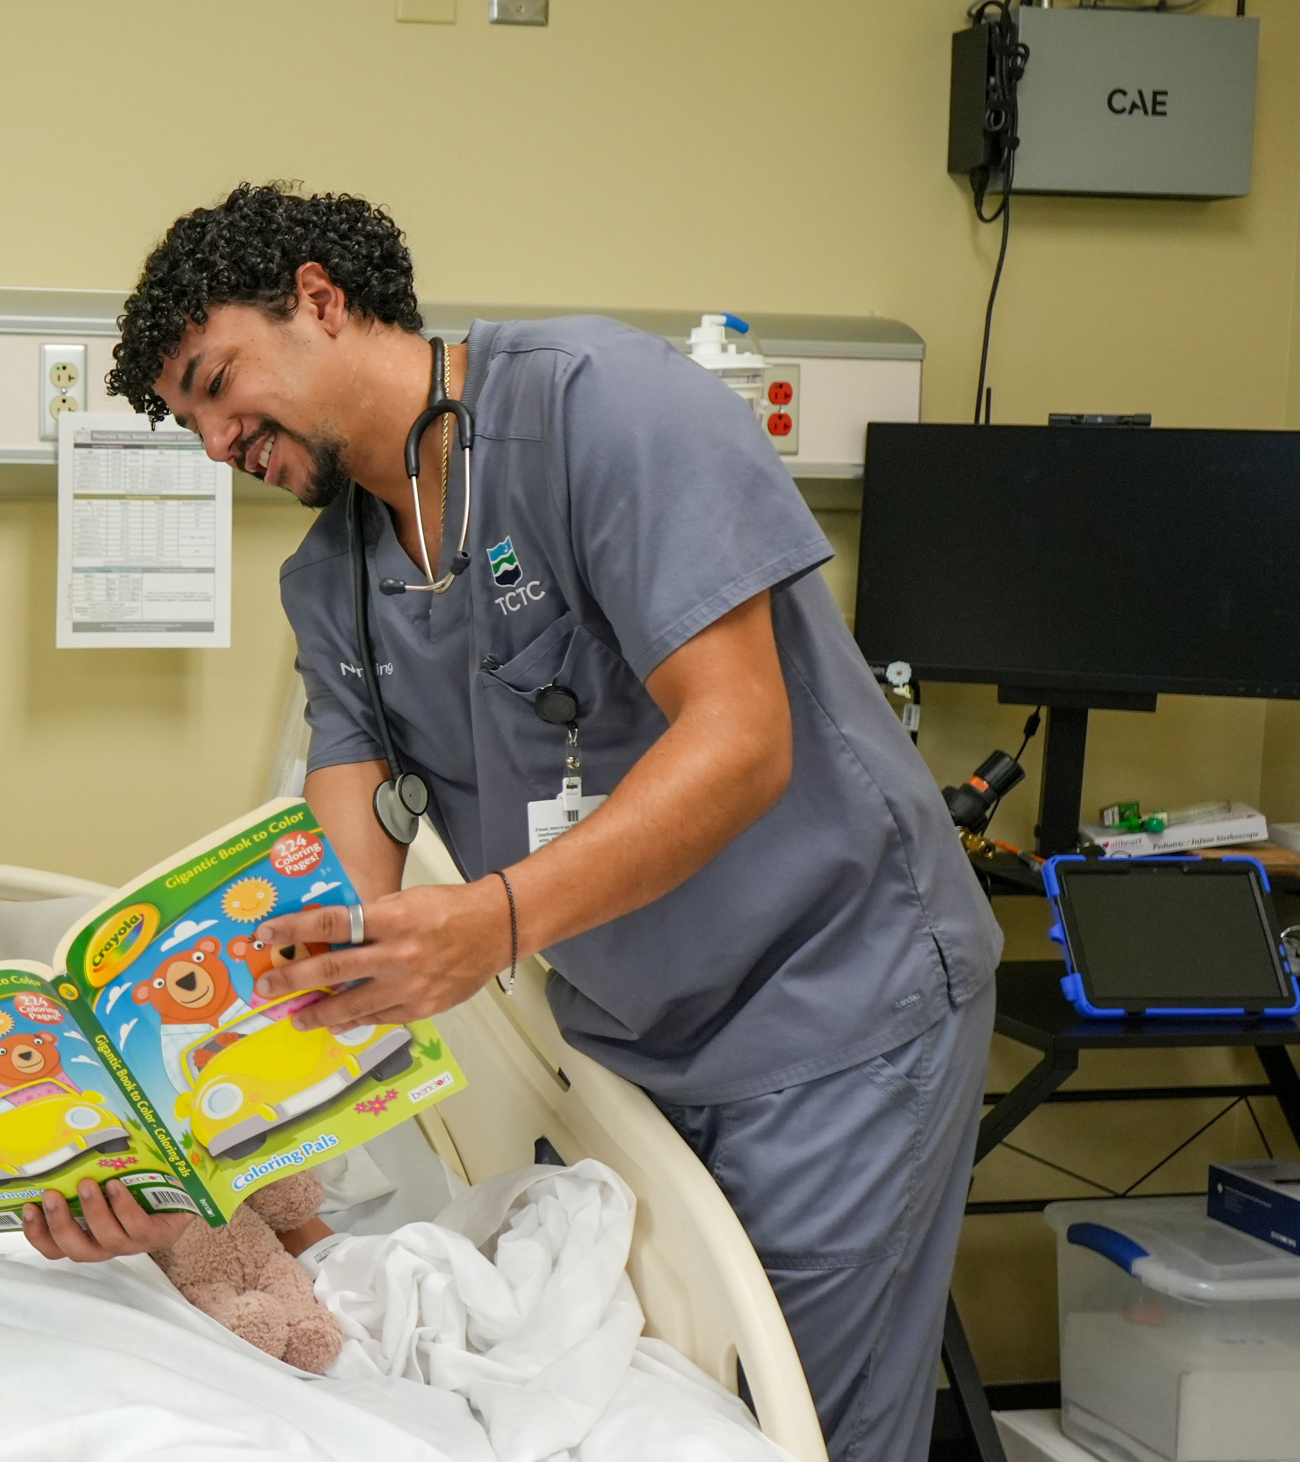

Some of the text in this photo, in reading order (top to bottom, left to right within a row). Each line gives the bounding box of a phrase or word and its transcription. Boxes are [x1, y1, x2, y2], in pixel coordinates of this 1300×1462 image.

[1107, 88, 1169, 116] CAE
[495, 581, 546, 616] TCTC
[165, 810, 305, 889] Gigantic Book to Color
[275, 843, 321, 868] Coloring
[276, 834, 307, 857] 224
[285, 852, 319, 874] Pages!
[91, 913, 142, 968] Crayola
[11, 974, 41, 988] Color
[19, 995, 48, 1007] 224
[19, 1004, 61, 1017] Coloring
[411, 1075, 450, 1100] bendon
[95, 1034, 122, 1070] Gigantic
[116, 1069, 136, 1097] Book
[130, 1091, 141, 1102] to
[137, 1100, 156, 1123] Color
[154, 1127, 180, 1163] Coloring
[175, 1161, 192, 1178] Pals
[233, 1134, 338, 1191] Coloring Pals
[123, 1174, 161, 1185] bendon
